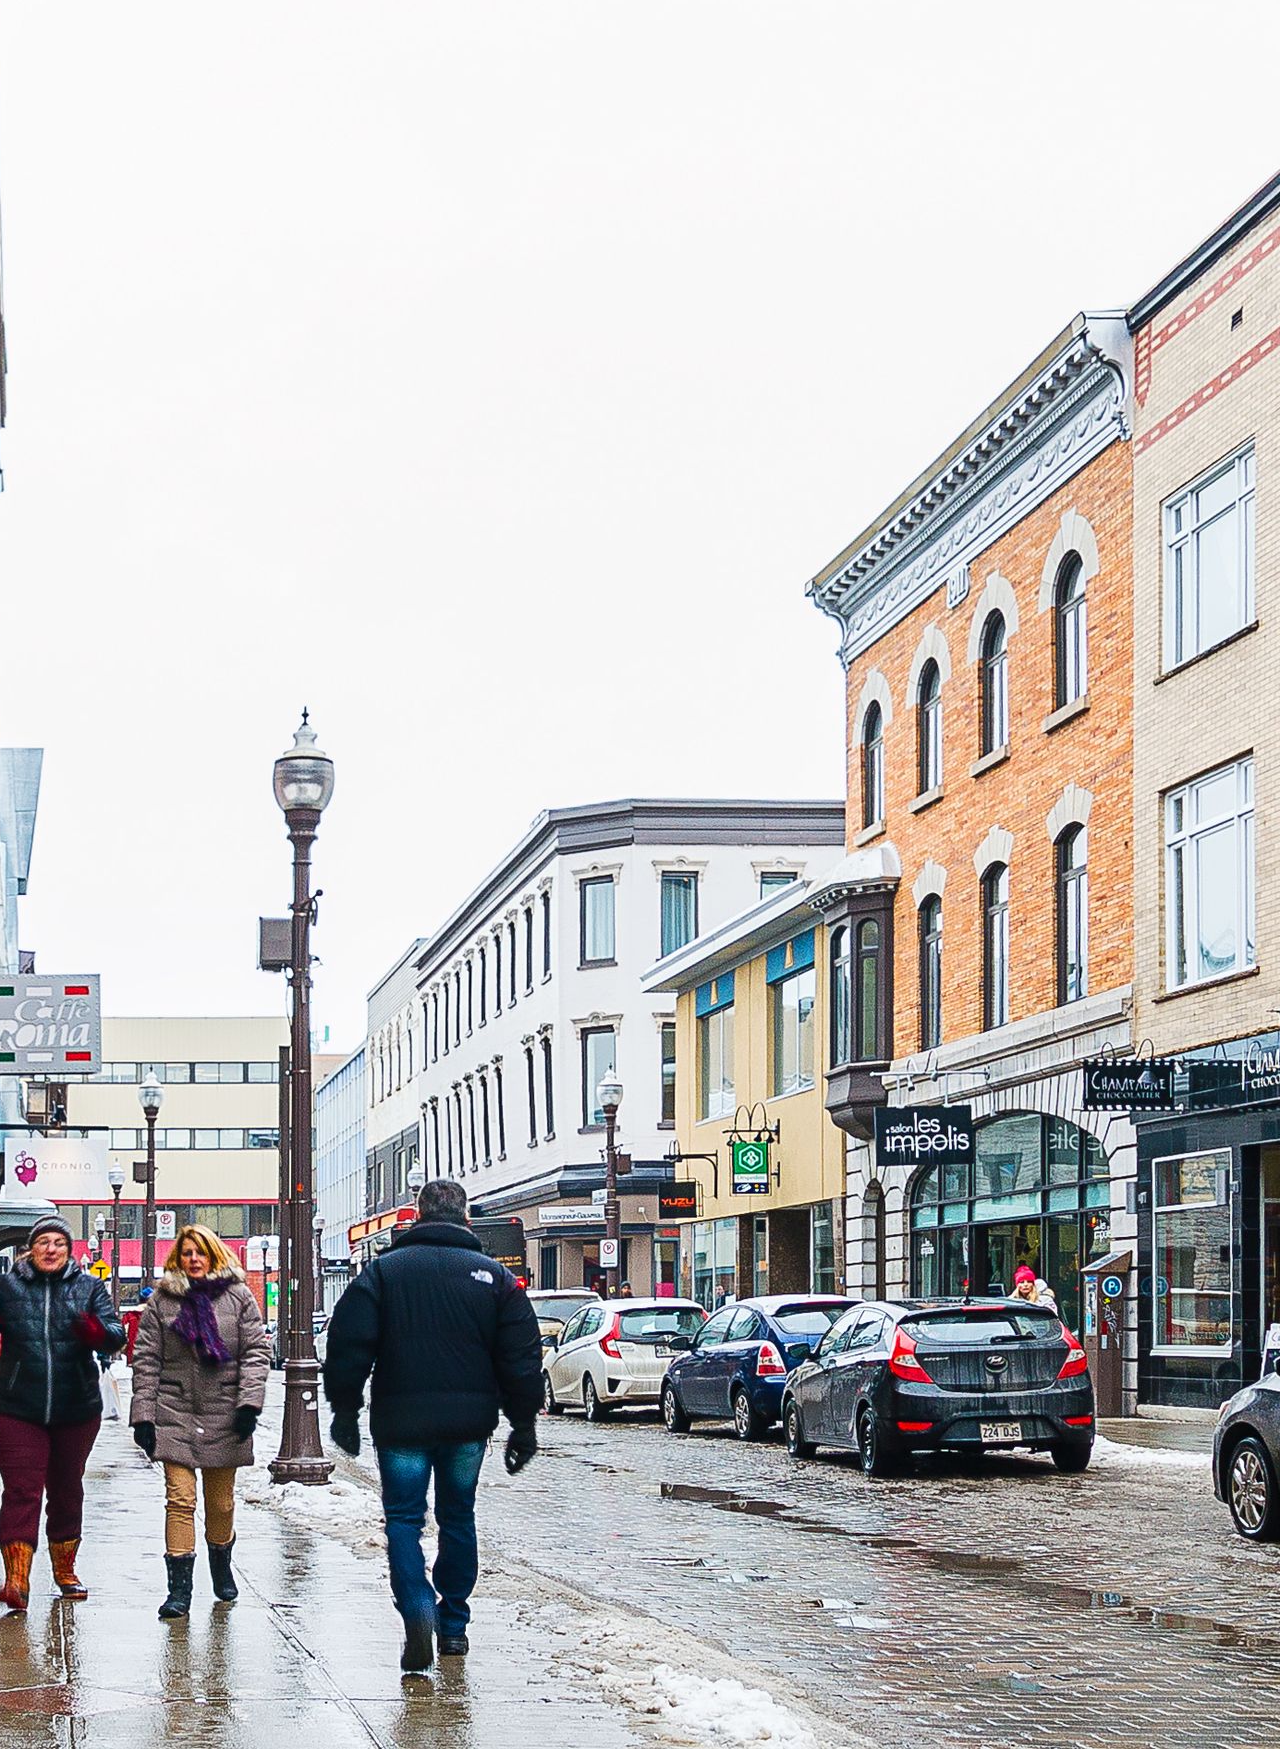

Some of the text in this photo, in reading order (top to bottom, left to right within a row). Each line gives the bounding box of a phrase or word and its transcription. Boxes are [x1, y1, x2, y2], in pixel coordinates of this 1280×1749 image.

[1096, 1091, 1161, 1100] CHOCOLATIER
[890, 1112, 940, 1134] salon les
[884, 1125, 970, 1158] impolis
[662, 1197, 695, 1207] YUZU
